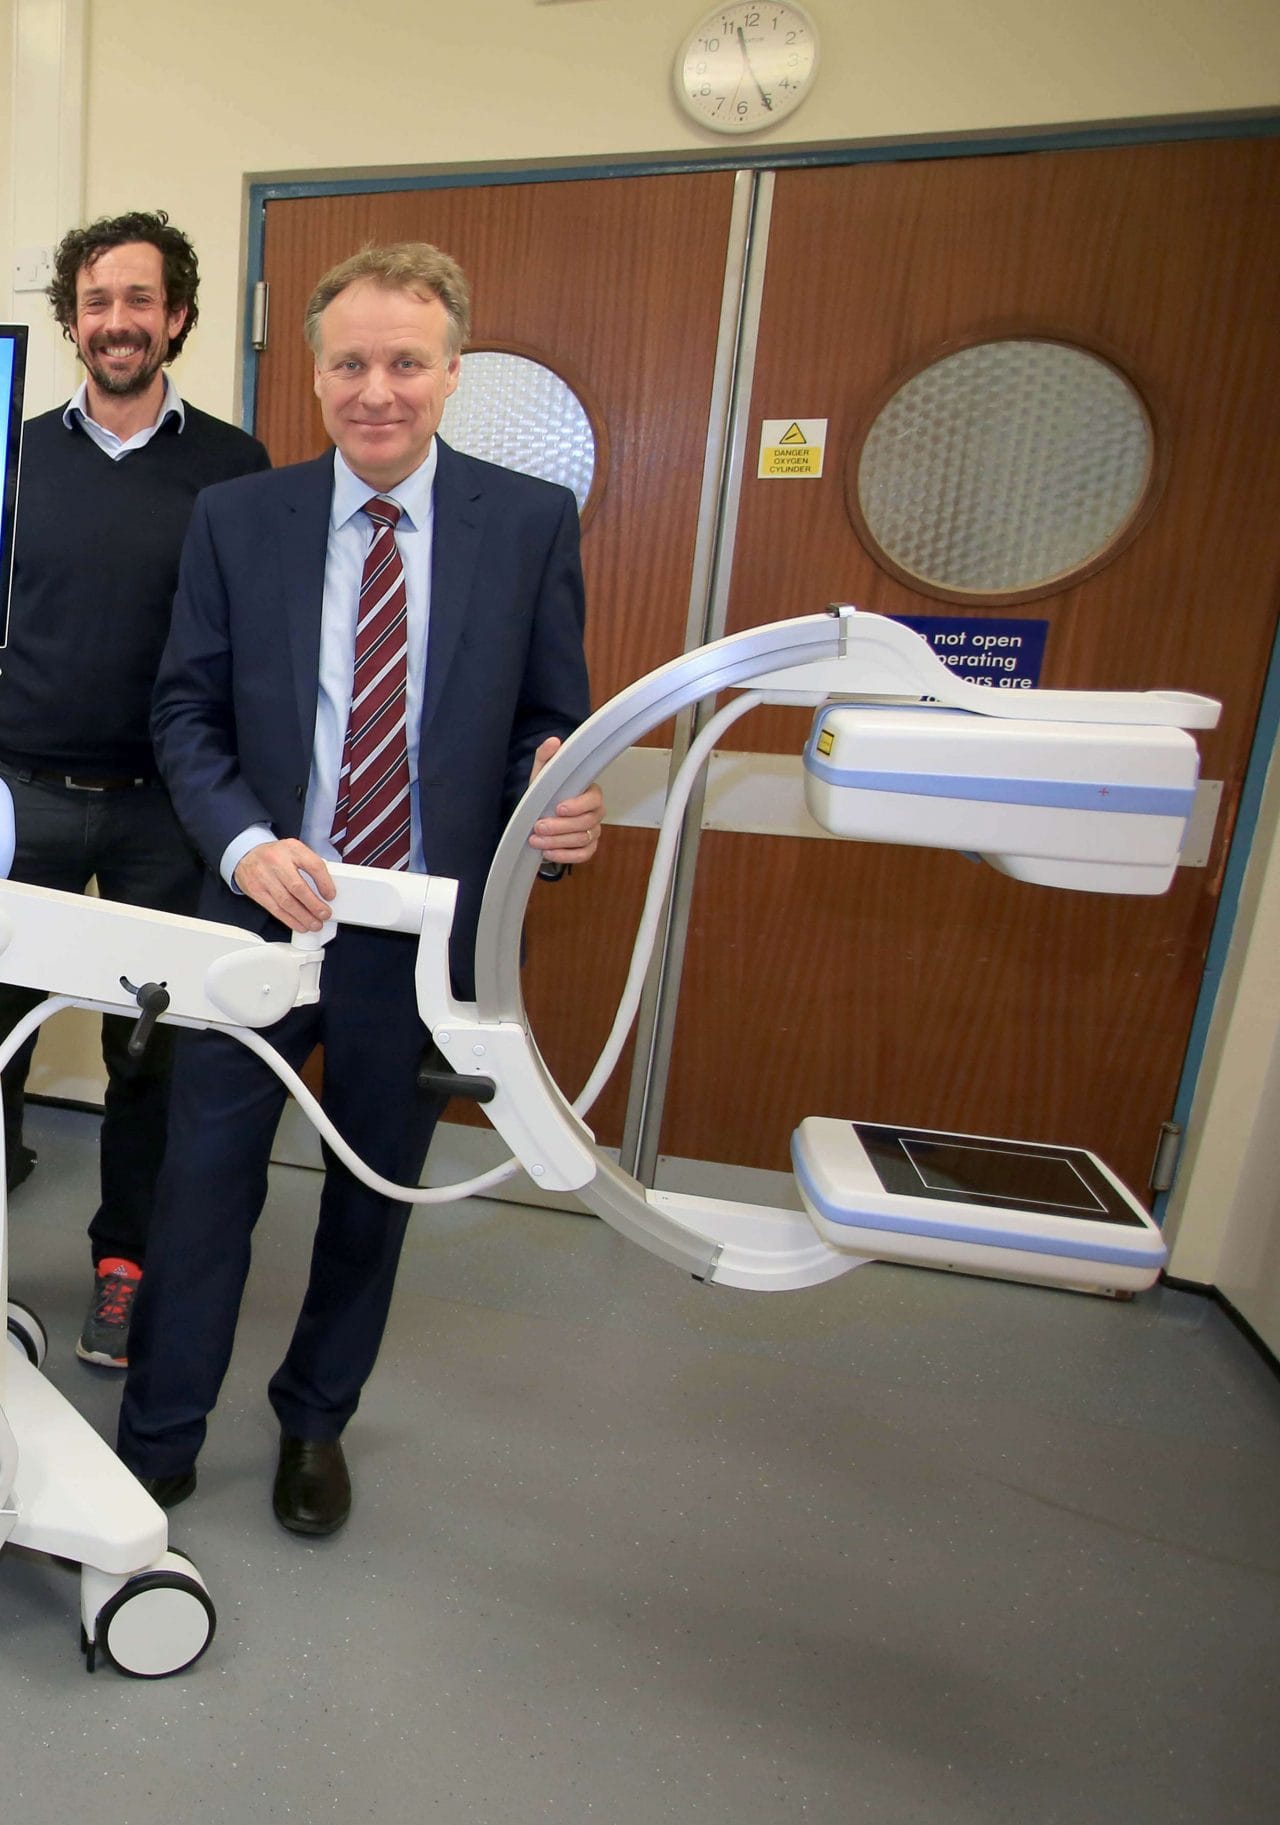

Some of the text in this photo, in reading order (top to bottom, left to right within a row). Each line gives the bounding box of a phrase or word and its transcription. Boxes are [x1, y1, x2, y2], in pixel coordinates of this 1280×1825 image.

[744, 13, 760, 27] 12
[772, 18, 777, 30] 1
[722, 21, 734, 35] 11
[704, 38, 720, 53] 10
[785, 32, 796, 45] 2
[787, 53, 799, 67] 3
[696, 62, 707, 75] 9
[778, 77, 790, 89] 4
[716, 97, 726, 110] 7
[737, 101, 748, 115] 6
[934, 632, 967, 645] not
[972, 633, 1022, 650] open
[936, 652, 1017, 672] perating
[963, 675, 1033, 689] ors are
